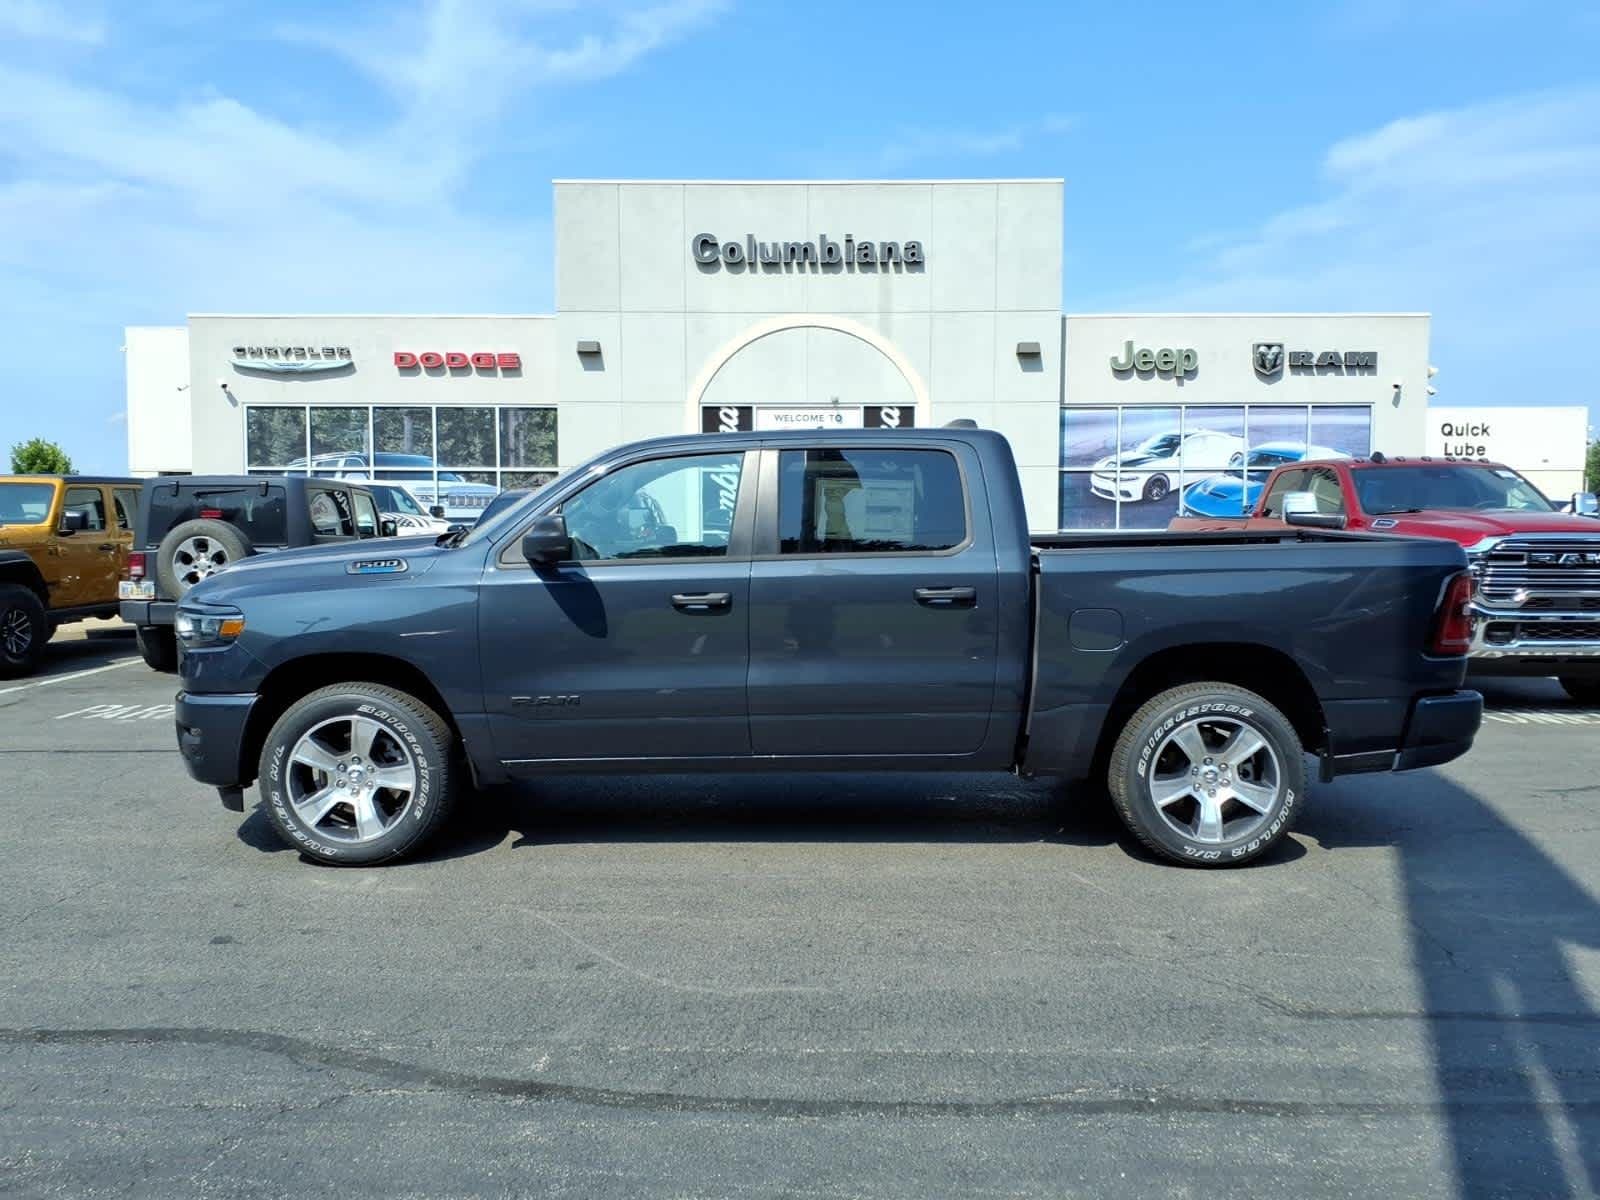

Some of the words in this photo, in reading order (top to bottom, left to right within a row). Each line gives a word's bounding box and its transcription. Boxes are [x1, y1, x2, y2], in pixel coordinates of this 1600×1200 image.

[692, 232, 924, 263] Columbiana
[232, 346, 352, 360] CHRYSLER
[394, 352, 520, 368] DODGE
[1110, 340, 1198, 376] Jeep
[1289, 351, 1377, 366] RAM
[774, 414, 824, 423] WELCOME
[1441, 422, 1490, 437] Quick
[1444, 442, 1486, 456] Lube
[353, 560, 400, 569] 1500
[511, 695, 580, 706] RAM
[1138, 703, 1253, 777] BRIDGESTONE
[357, 704, 431, 820] BRIDGESTONE
